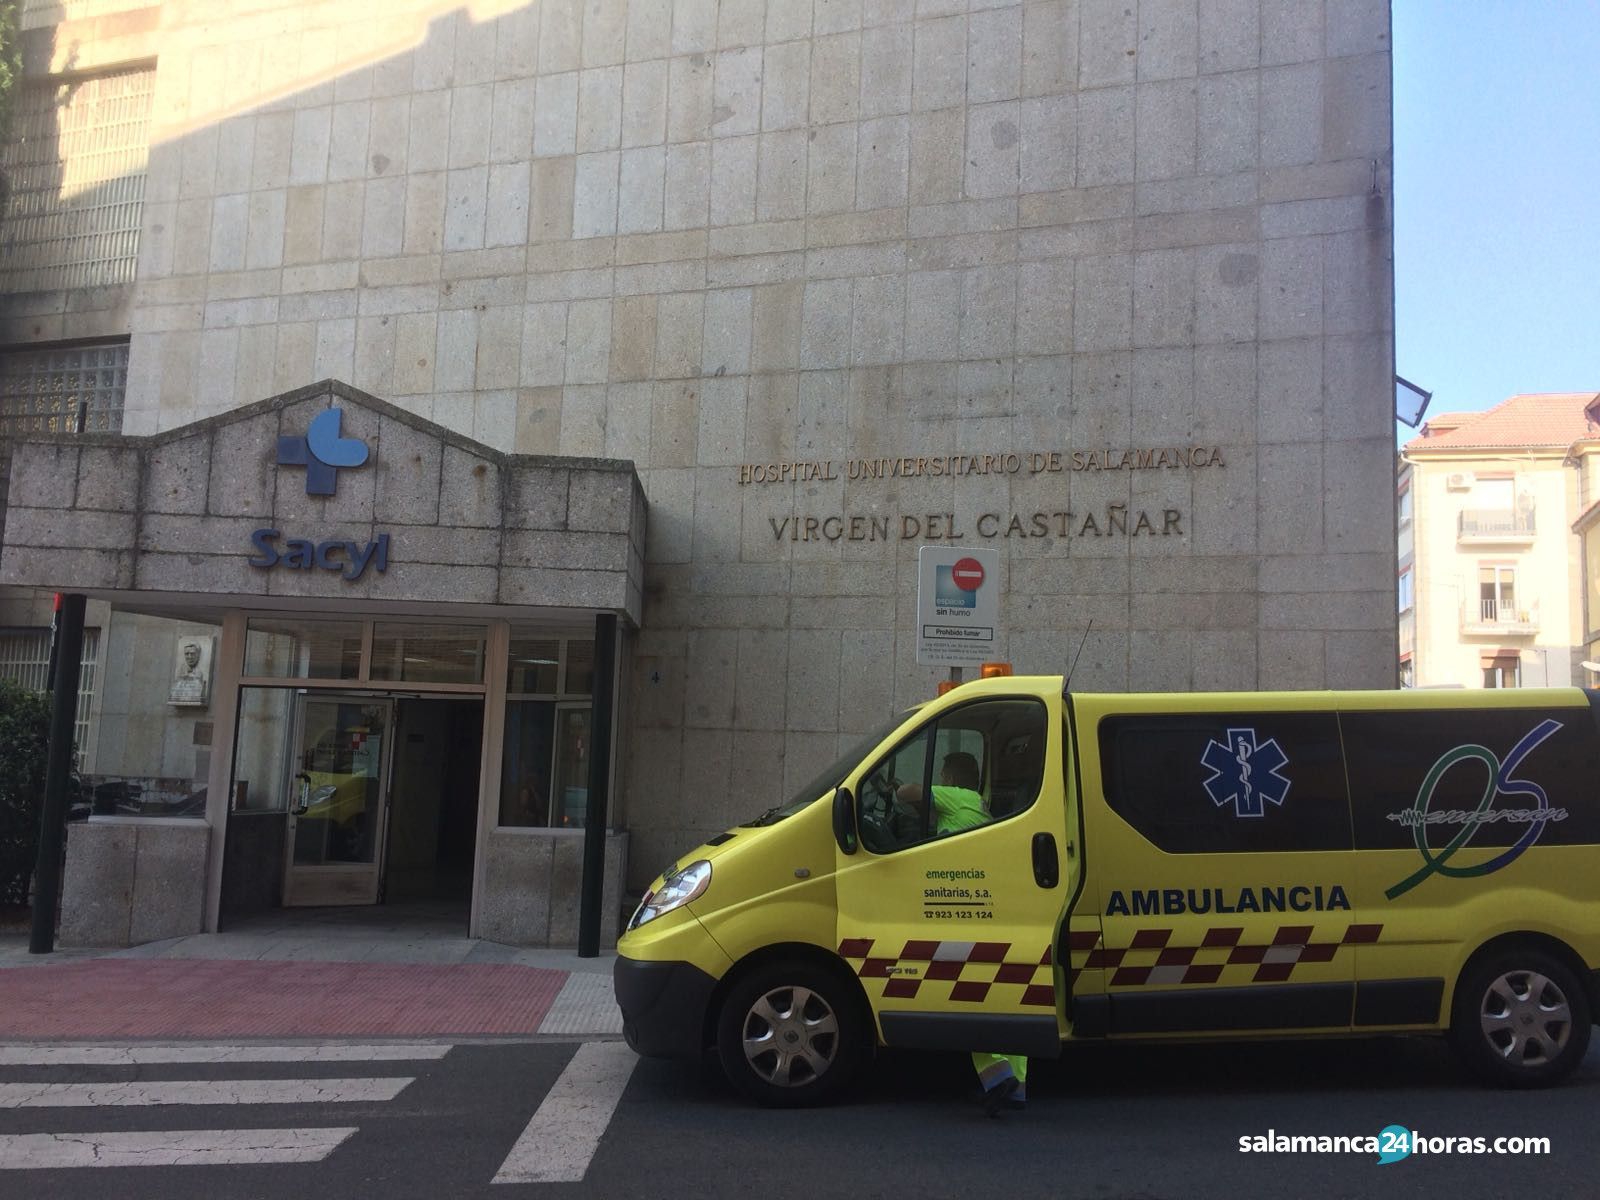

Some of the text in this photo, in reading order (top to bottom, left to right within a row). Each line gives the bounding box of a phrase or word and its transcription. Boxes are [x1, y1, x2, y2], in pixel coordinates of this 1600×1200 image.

[738, 447, 1226, 484] HOSPITAL UNIVERSITARIO DE SALAMANCA
[768, 503, 1183, 541] VIRGEN DEL CASTAÑAR
[249, 528, 390, 581] Sacyl
[936, 608, 971, 617] sin humo
[935, 628, 963, 636] Prohibido
[926, 868, 985, 881] emergencias
[924, 887, 992, 899] sanitarias, s.a.
[1105, 885, 1352, 916] AMBULANCIA
[935, 911, 993, 919] 923 123 124
